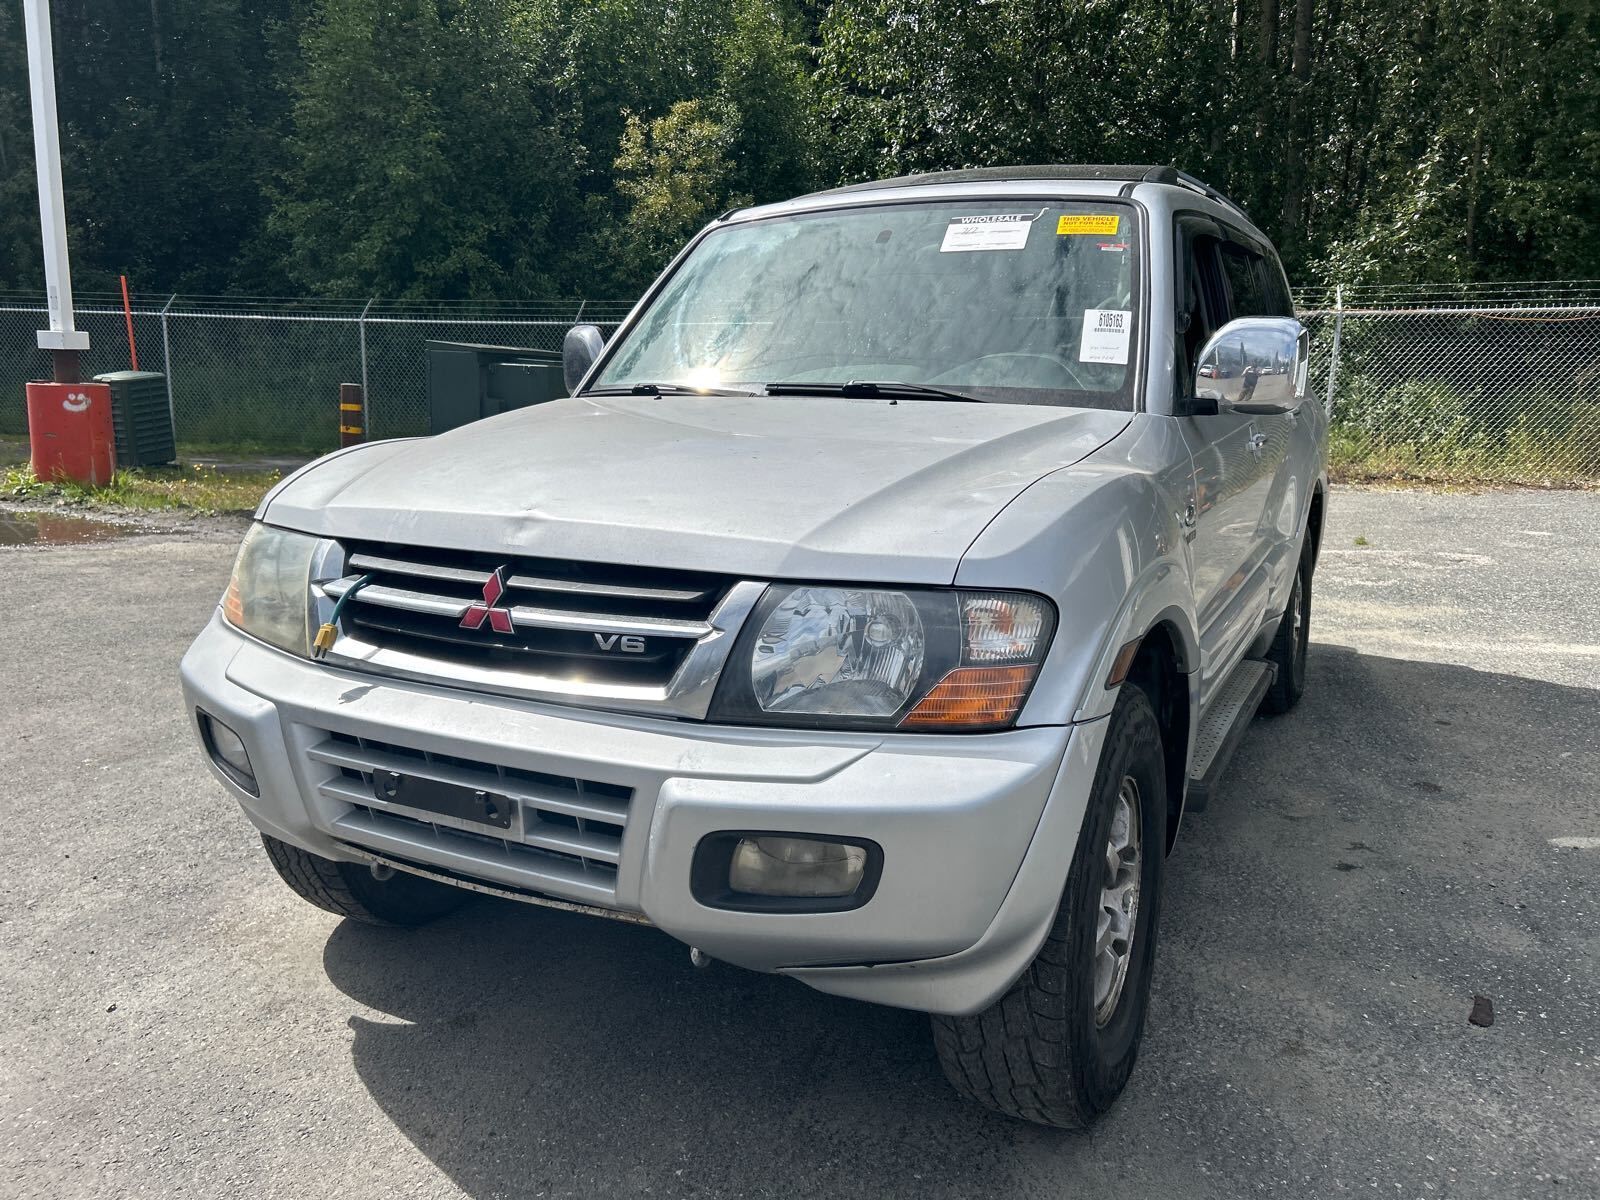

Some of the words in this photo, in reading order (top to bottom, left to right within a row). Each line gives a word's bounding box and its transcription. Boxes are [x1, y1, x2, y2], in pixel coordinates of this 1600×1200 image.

[961, 215, 1022, 224] WHOLESALE
[1098, 313, 1124, 328] 6105163
[594, 633, 645, 653] V6
